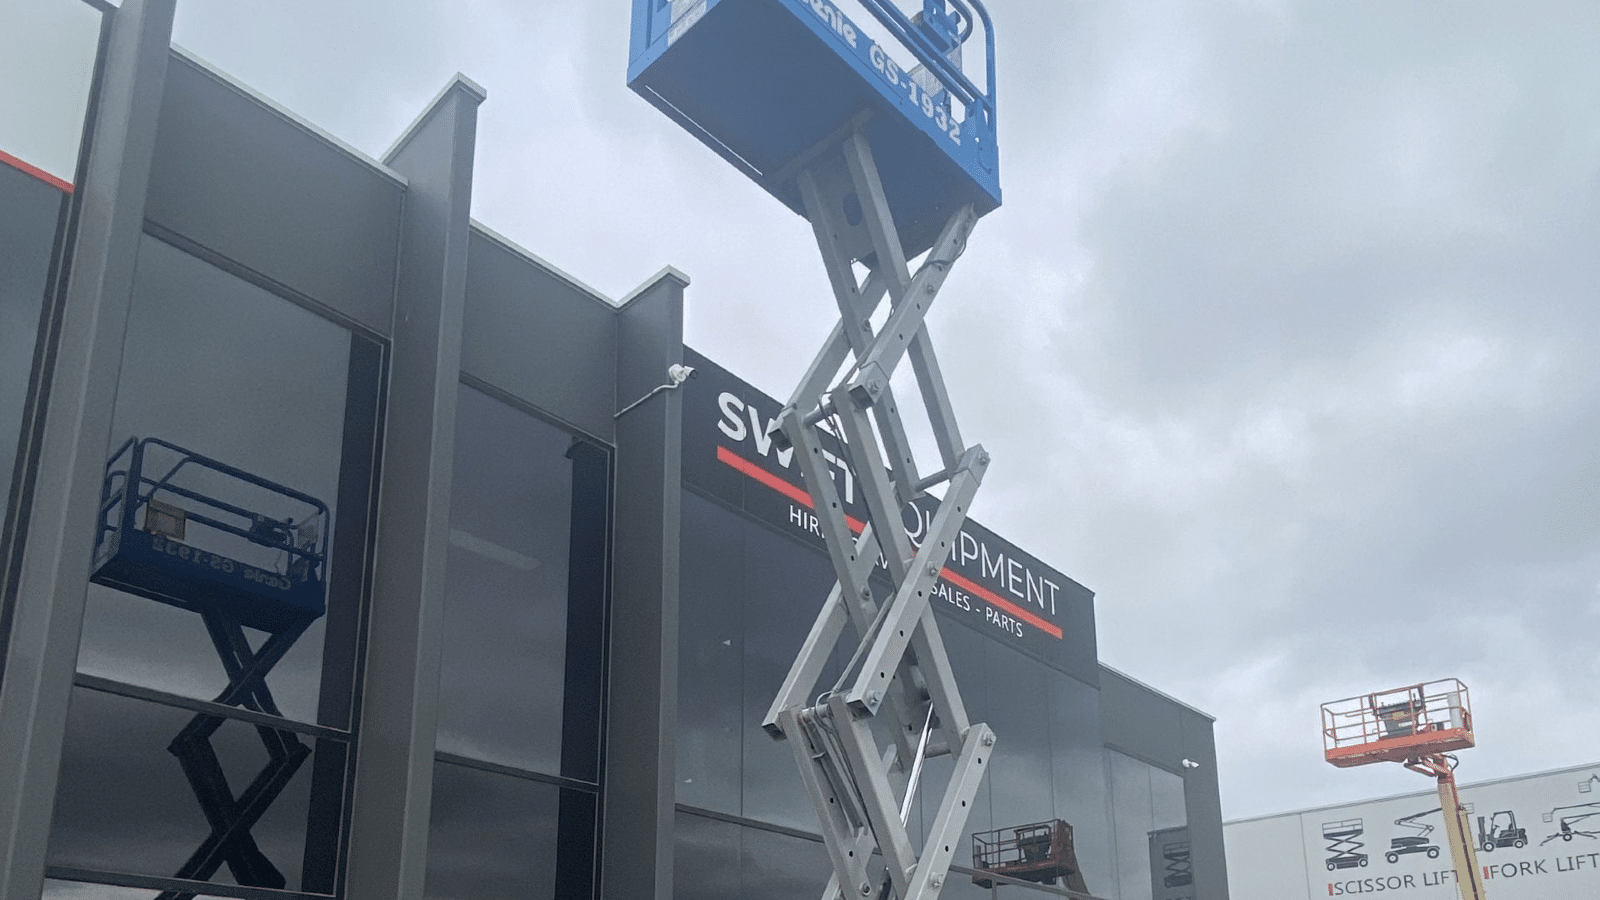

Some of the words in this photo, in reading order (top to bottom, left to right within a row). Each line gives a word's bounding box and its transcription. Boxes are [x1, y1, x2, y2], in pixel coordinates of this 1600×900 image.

[803, 0, 858, 49] enie
[869, 43, 962, 146] GS-1932
[717, 391, 857, 505] SWT
[901, 501, 1060, 616] QIPMENT
[789, 504, 826, 539] HIR
[985, 606, 1023, 638] PARTS
[1333, 875, 1417, 896] SCISSOR
[1489, 859, 1548, 880] FORK
[1556, 852, 1600, 872] LIFT
